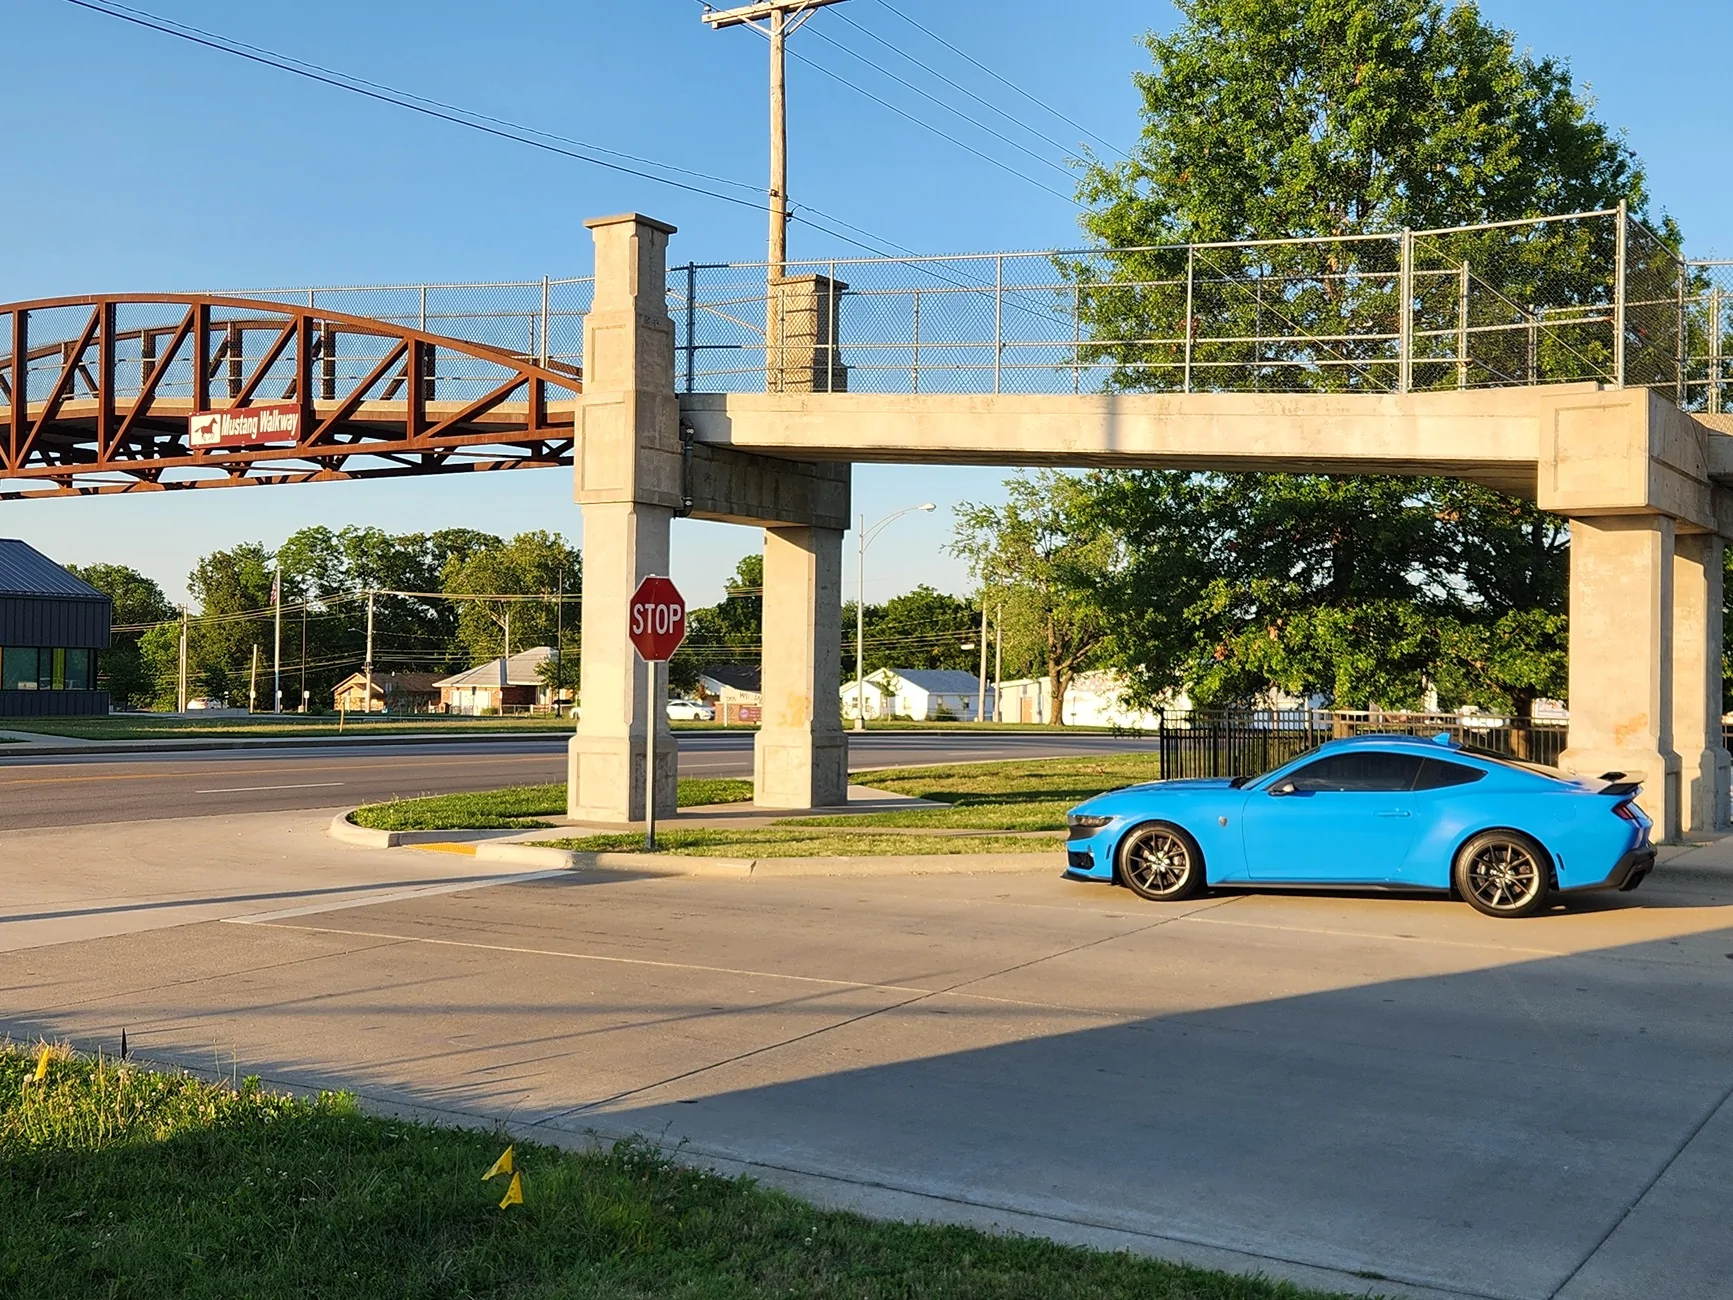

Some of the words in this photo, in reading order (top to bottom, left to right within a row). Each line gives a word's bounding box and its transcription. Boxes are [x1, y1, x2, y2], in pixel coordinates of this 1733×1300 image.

[221, 414, 258, 439] Mustang
[260, 409, 299, 436] Walkway
[633, 603, 682, 635] STOP
